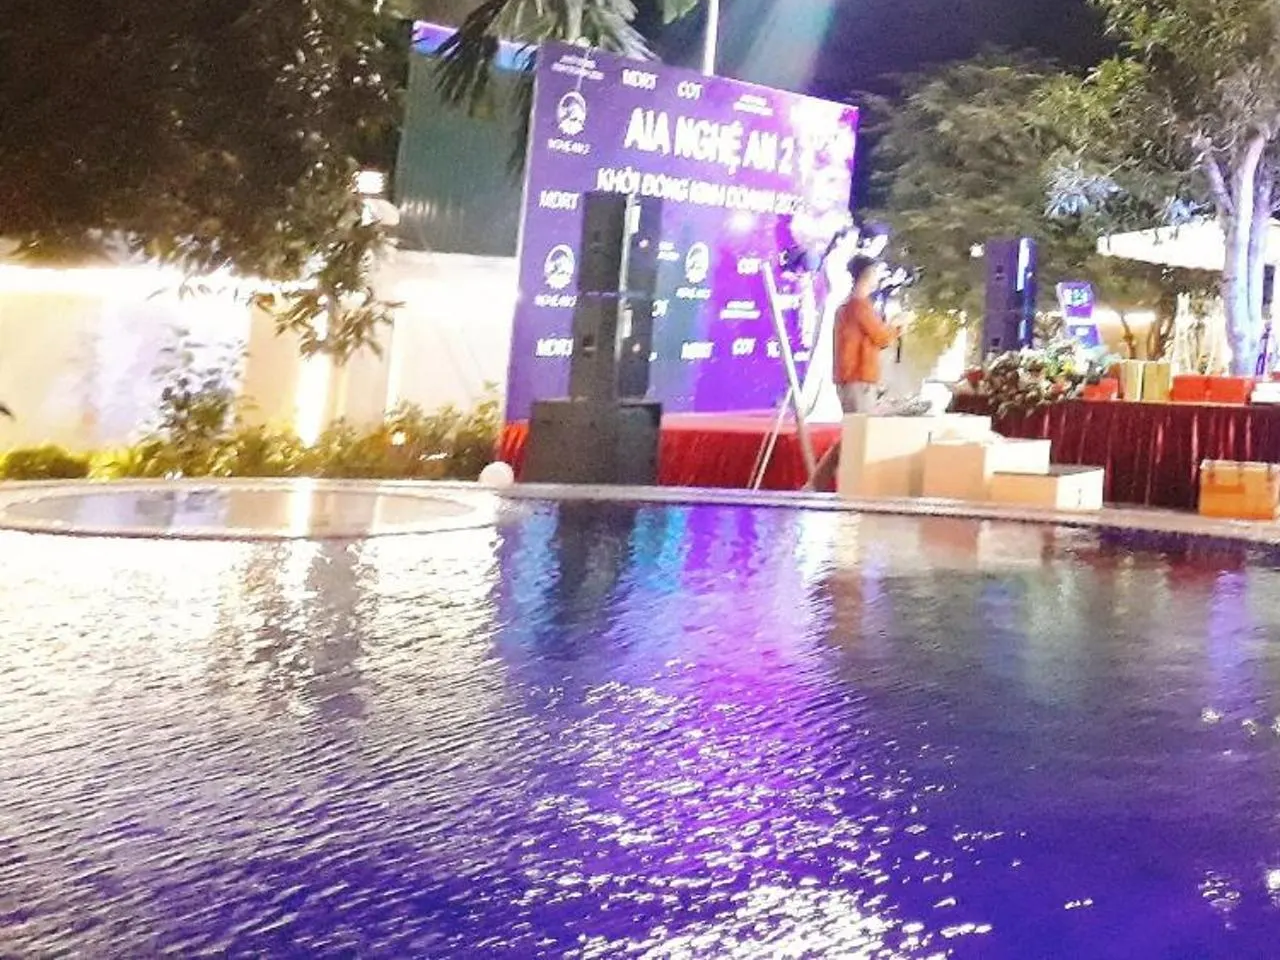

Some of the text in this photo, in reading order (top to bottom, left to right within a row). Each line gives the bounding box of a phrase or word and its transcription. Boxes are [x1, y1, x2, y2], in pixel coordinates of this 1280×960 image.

[624, 107, 672, 157] AIA
[742, 130, 778, 172] AN
[778, 136, 795, 175] 2
